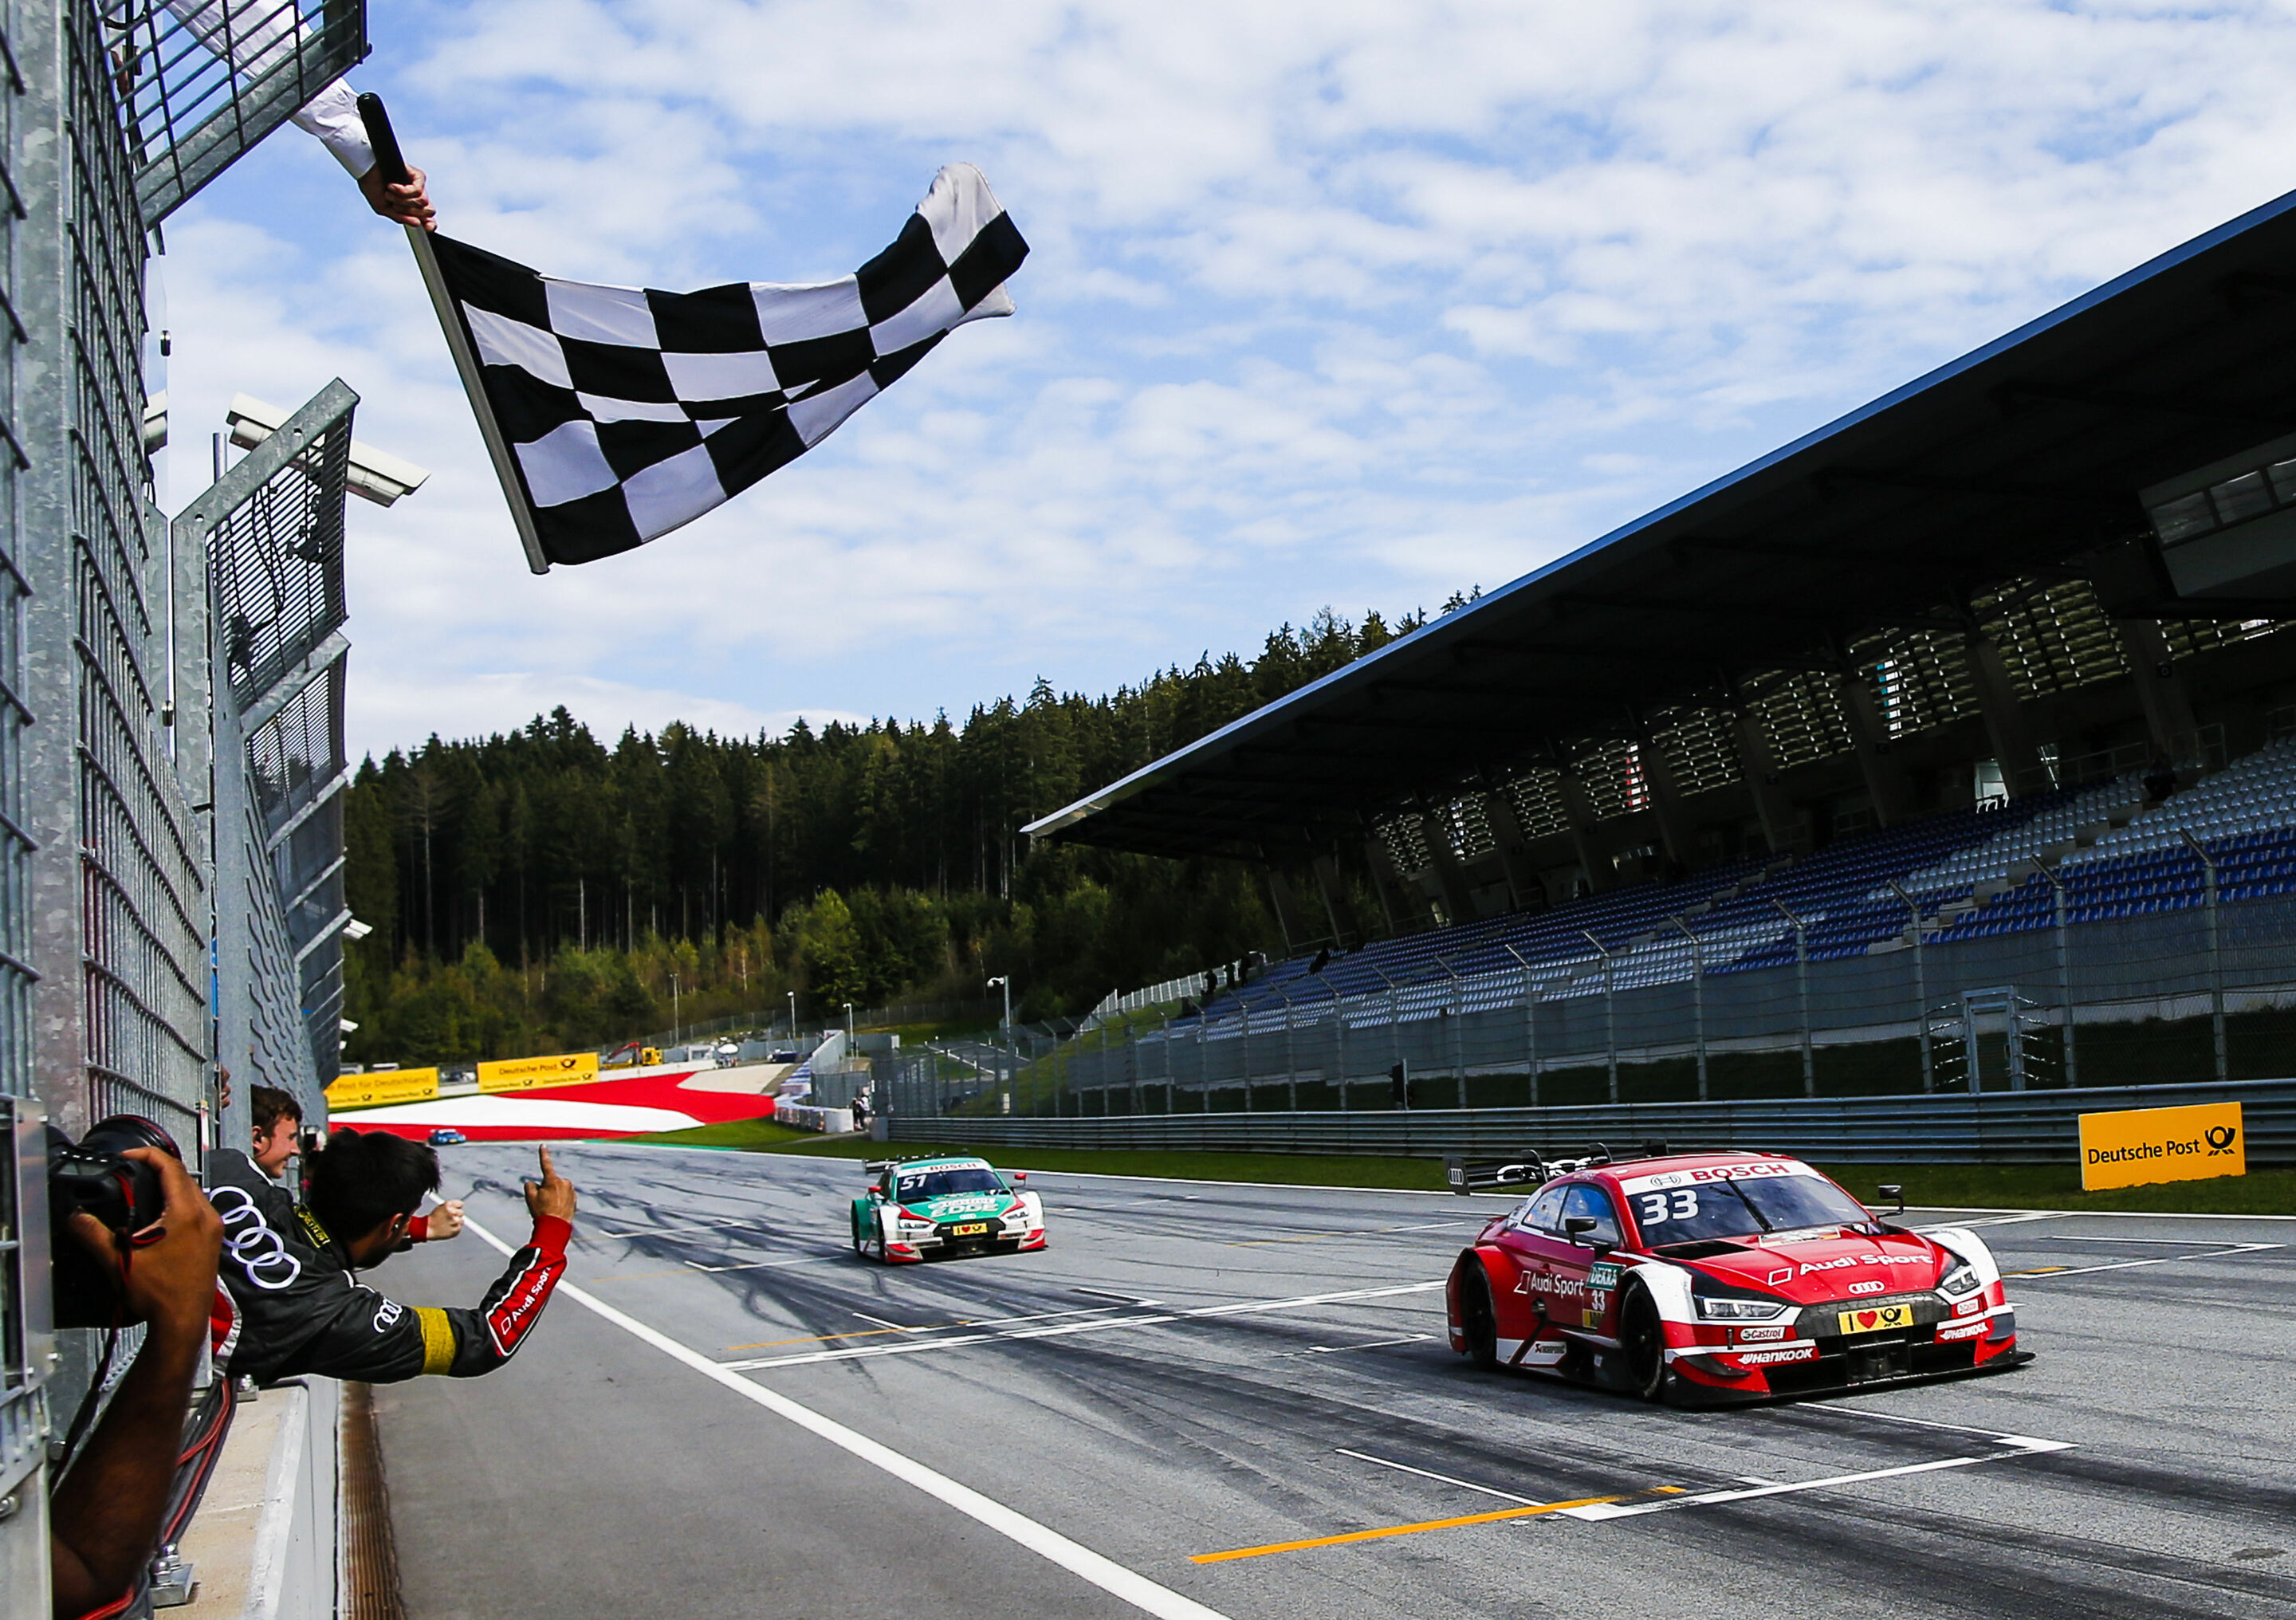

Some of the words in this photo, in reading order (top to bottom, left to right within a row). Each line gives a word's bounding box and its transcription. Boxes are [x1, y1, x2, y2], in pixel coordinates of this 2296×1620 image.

[499, 1066, 538, 1075] Deutsche
[540, 1064, 557, 1072] Post
[2088, 1142, 2163, 1164] Deutsche
[2166, 1139, 2201, 1156] Post
[930, 1162, 977, 1171] BOSCH
[1690, 1164, 1791, 1182] BOSCH
[899, 1174, 927, 1191] 51
[1641, 1189, 1699, 1226] 33
[1799, 1256, 1858, 1276] Audi
[1860, 1253, 1934, 1266] Sport
[1531, 1272, 1553, 1292] Audi
[1554, 1274, 1585, 1299] Sport
[1590, 1266, 1618, 1286] DEKRA
[512, 1294, 536, 1322] Audi
[1591, 1289, 1606, 1311] 33
[1751, 1328, 1782, 1339] Castrol
